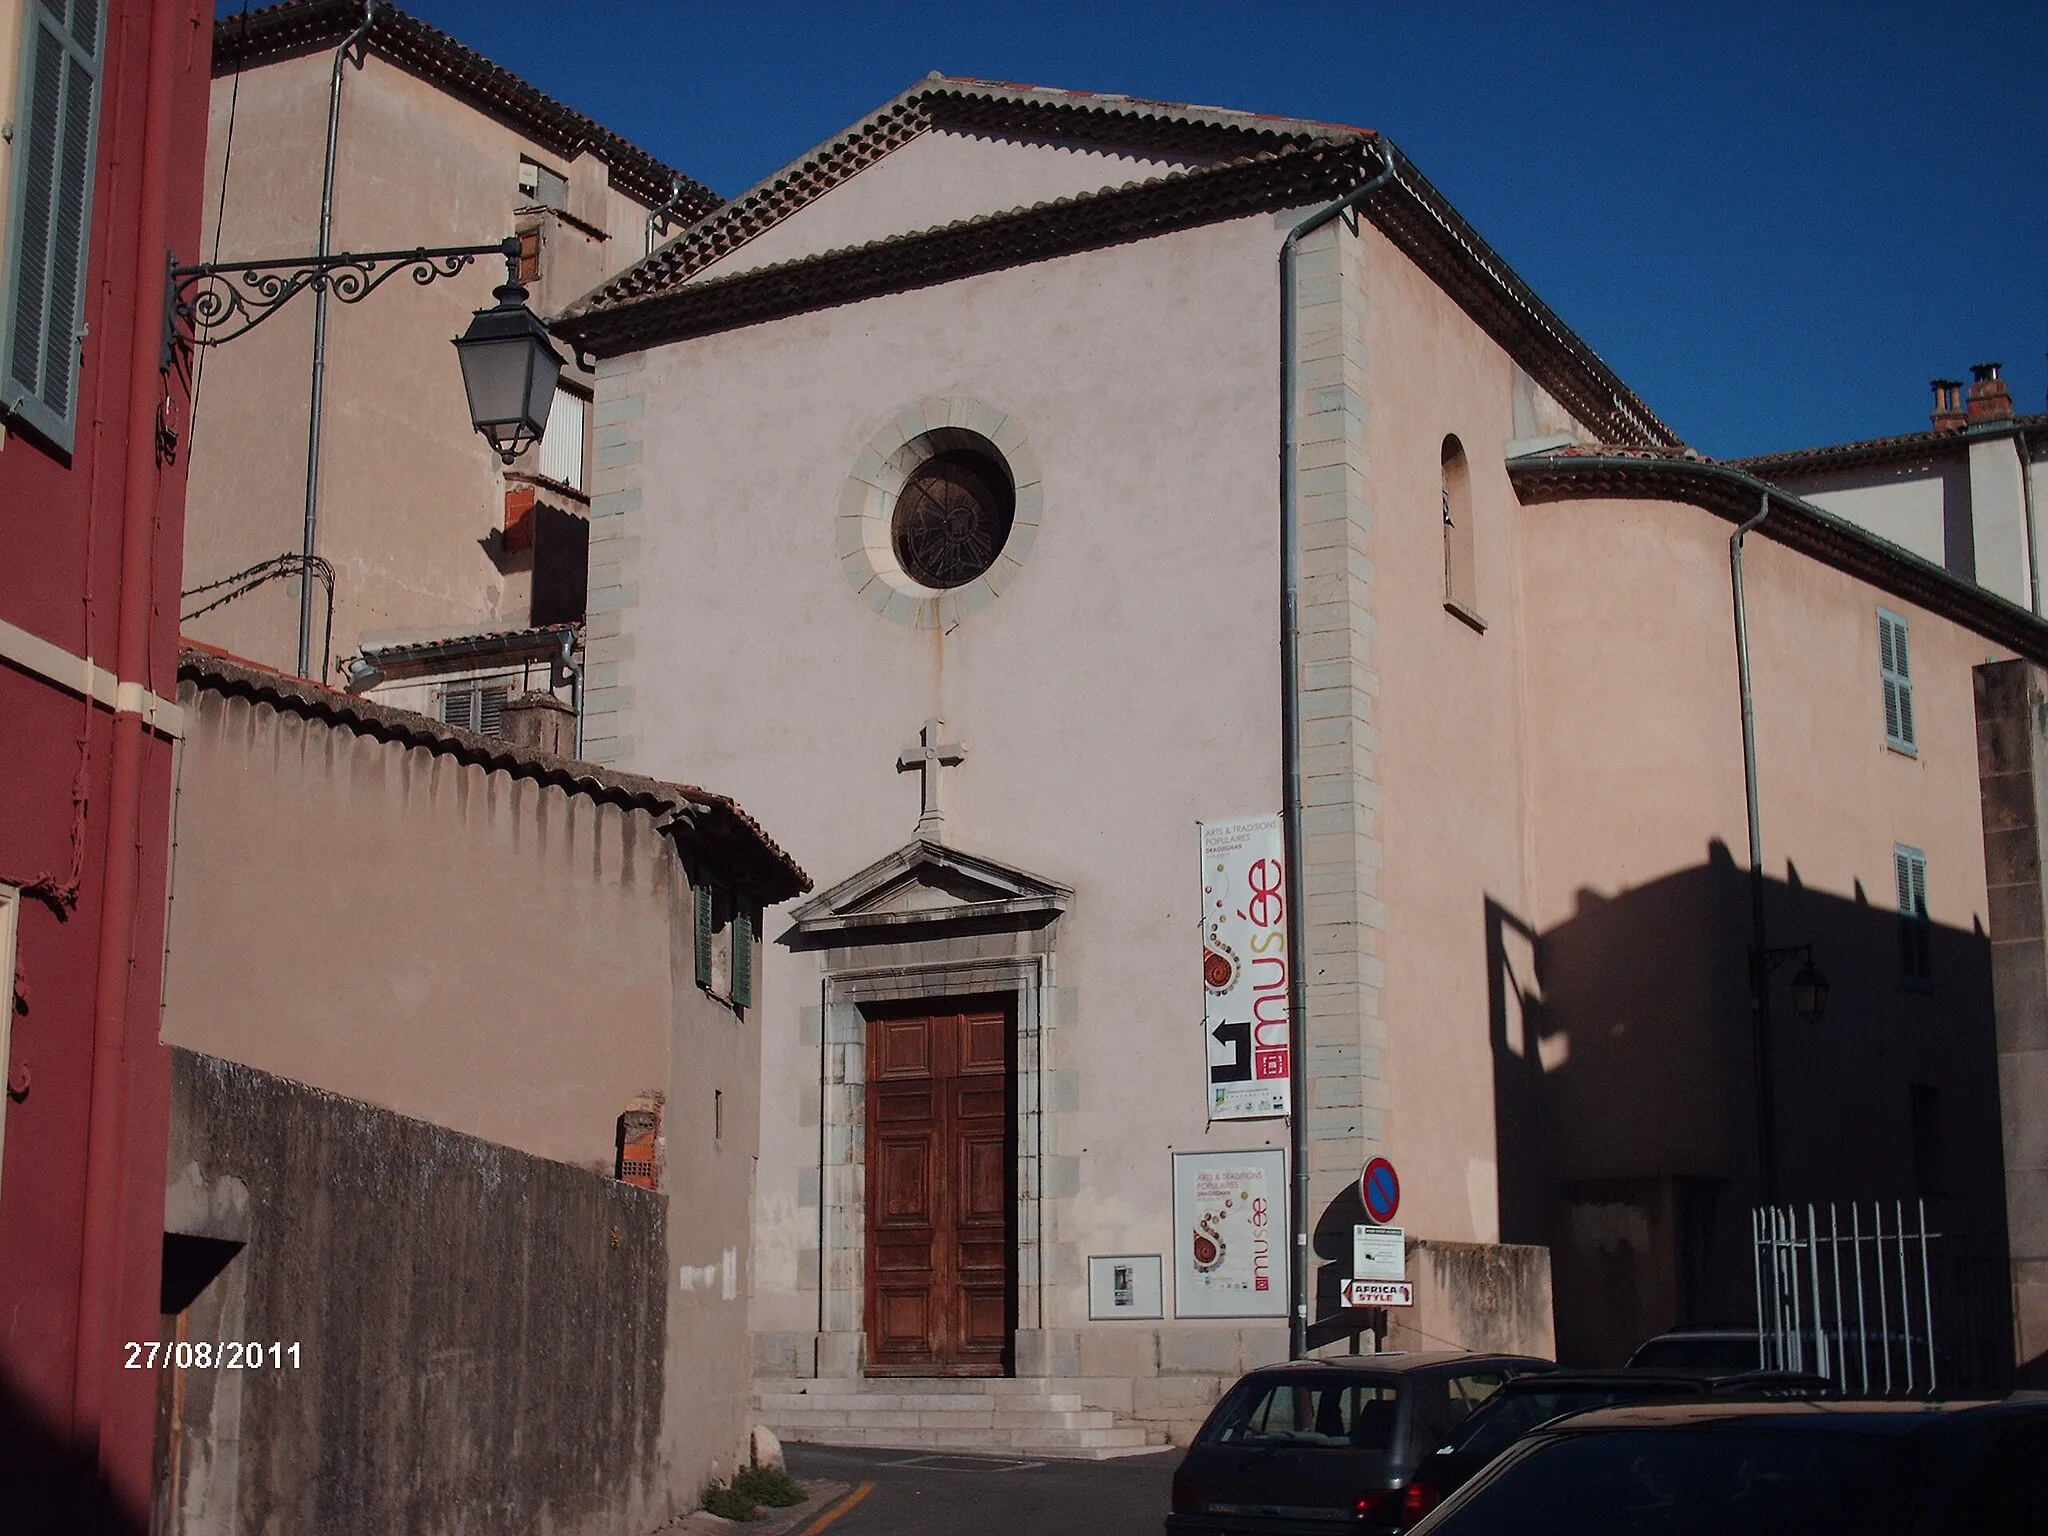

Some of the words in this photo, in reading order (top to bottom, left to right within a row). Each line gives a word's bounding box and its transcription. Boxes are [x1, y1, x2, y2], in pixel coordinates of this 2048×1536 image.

[1205, 827, 1223, 837] ARTS
[1233, 821, 1277, 833] TRADITIONS
[1205, 833, 1250, 846] POPULAIRES
[1355, 1285, 1397, 1294] AFRICA
[1359, 1294, 1393, 1302] STYLE
